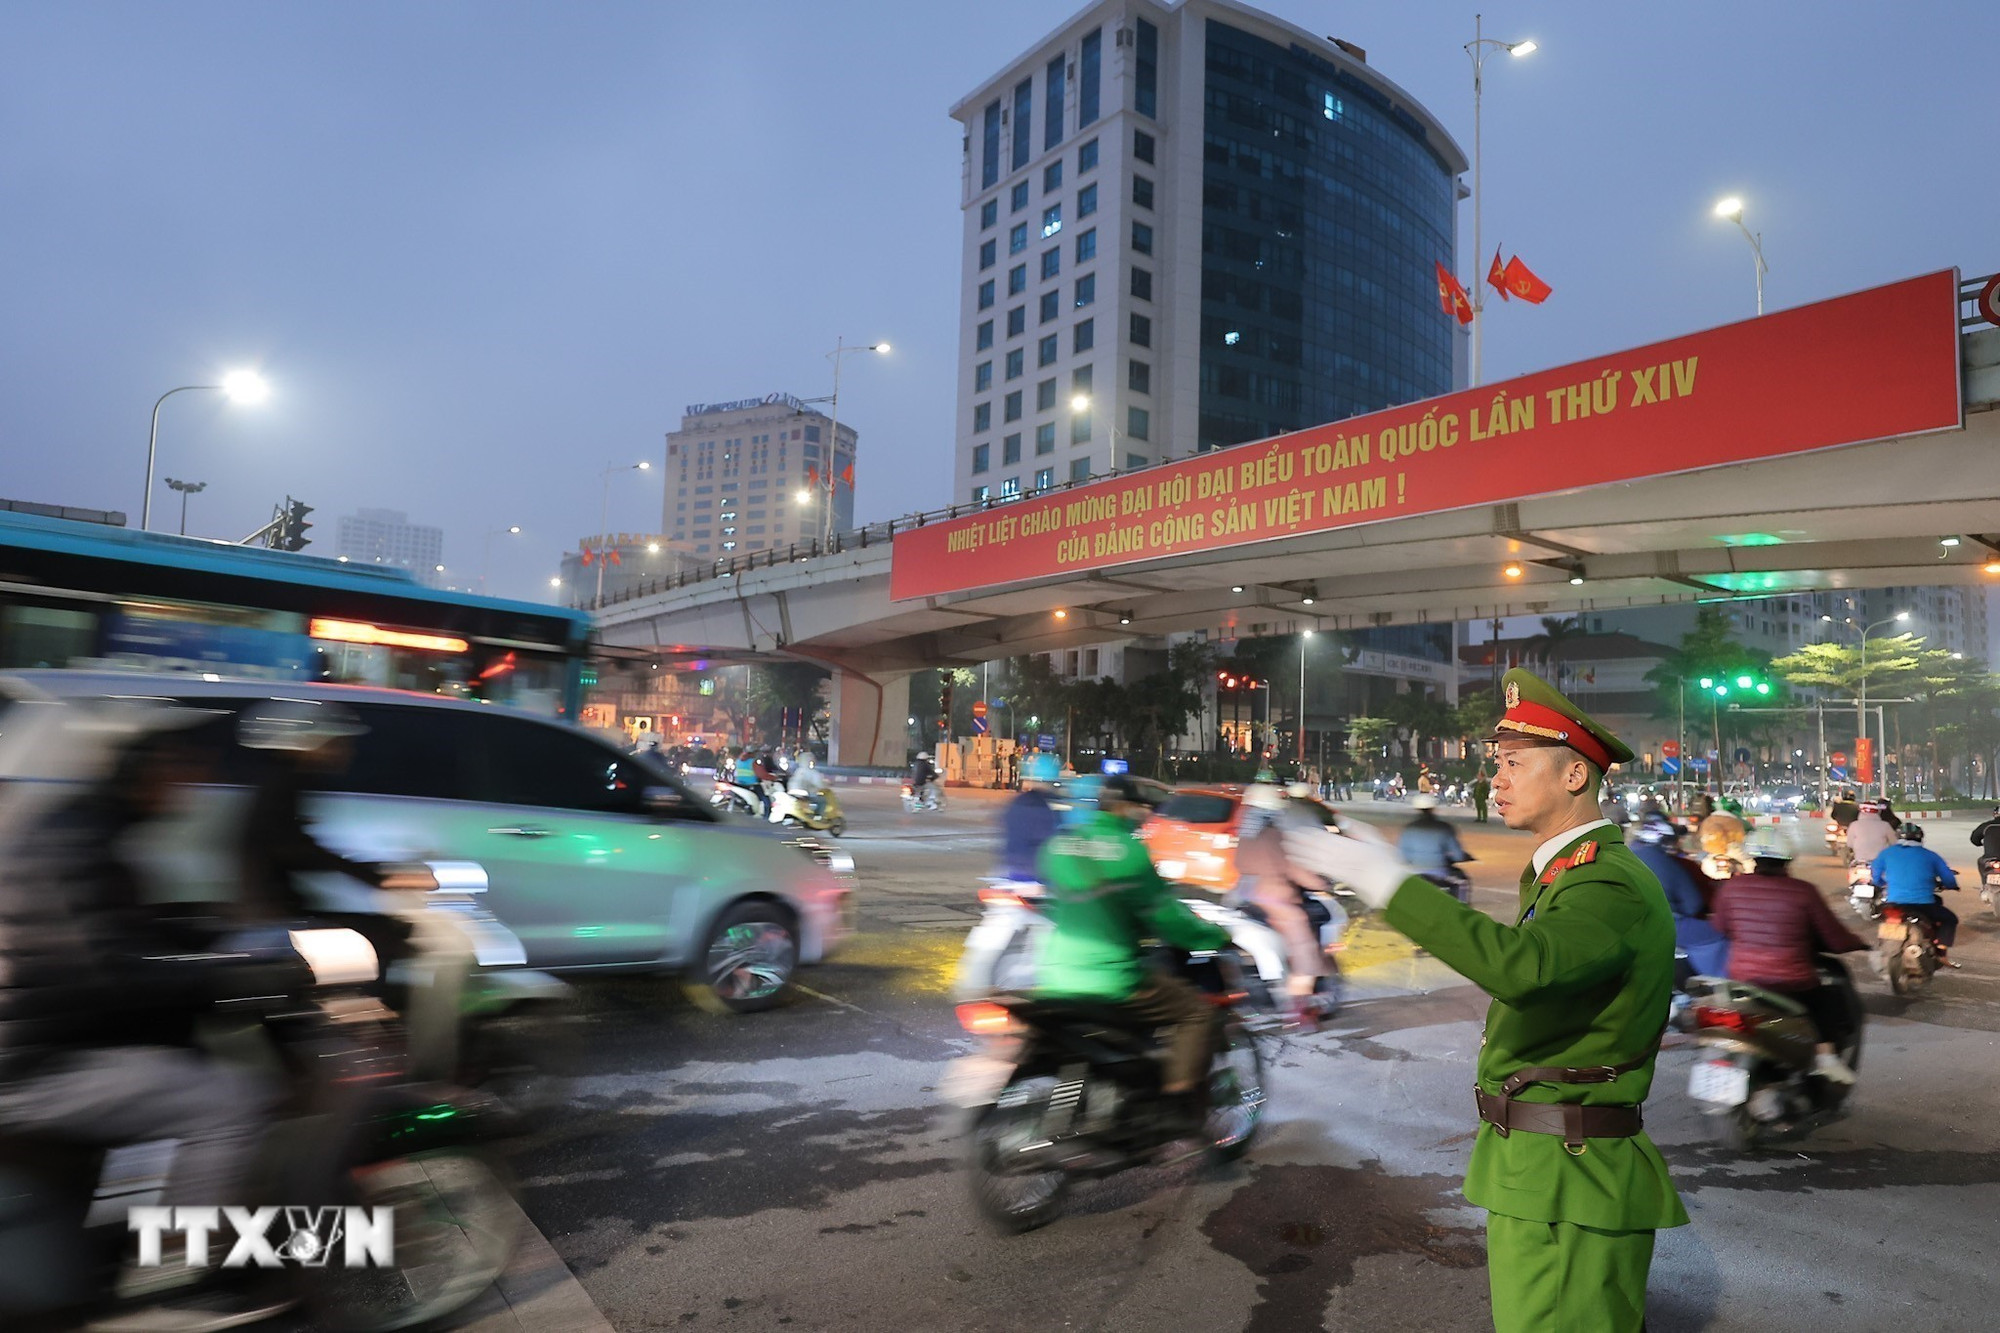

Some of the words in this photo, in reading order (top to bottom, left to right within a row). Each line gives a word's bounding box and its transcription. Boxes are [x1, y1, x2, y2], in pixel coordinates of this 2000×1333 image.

[948, 523, 986, 552] NHIỆT
[988, 515, 1018, 546] LIỆT
[1021, 507, 1061, 537] CHÀO
[1066, 493, 1118, 528] MỪNG
[1120, 485, 1153, 519] ĐẠI
[1158, 473, 1192, 511] HỘI
[1198, 466, 1234, 502] ĐẠI
[1240, 444, 1294, 490] BIỂU
[1301, 433, 1370, 478] TOÀN
[1379, 406, 1460, 463] QUỐC
[1470, 390, 1536, 441] LẦN
[1546, 368, 1623, 424] THỨ
[1631, 356, 1699, 407] XIV
[1056, 529, 1090, 564] CỦA
[1094, 522, 1145, 558] ĐẢNG
[1149, 512, 1205, 552] CỘNG
[1210, 496, 1257, 538] SẢN
[1264, 488, 1317, 530] VIỆT
[1322, 476, 1387, 517] NAM
